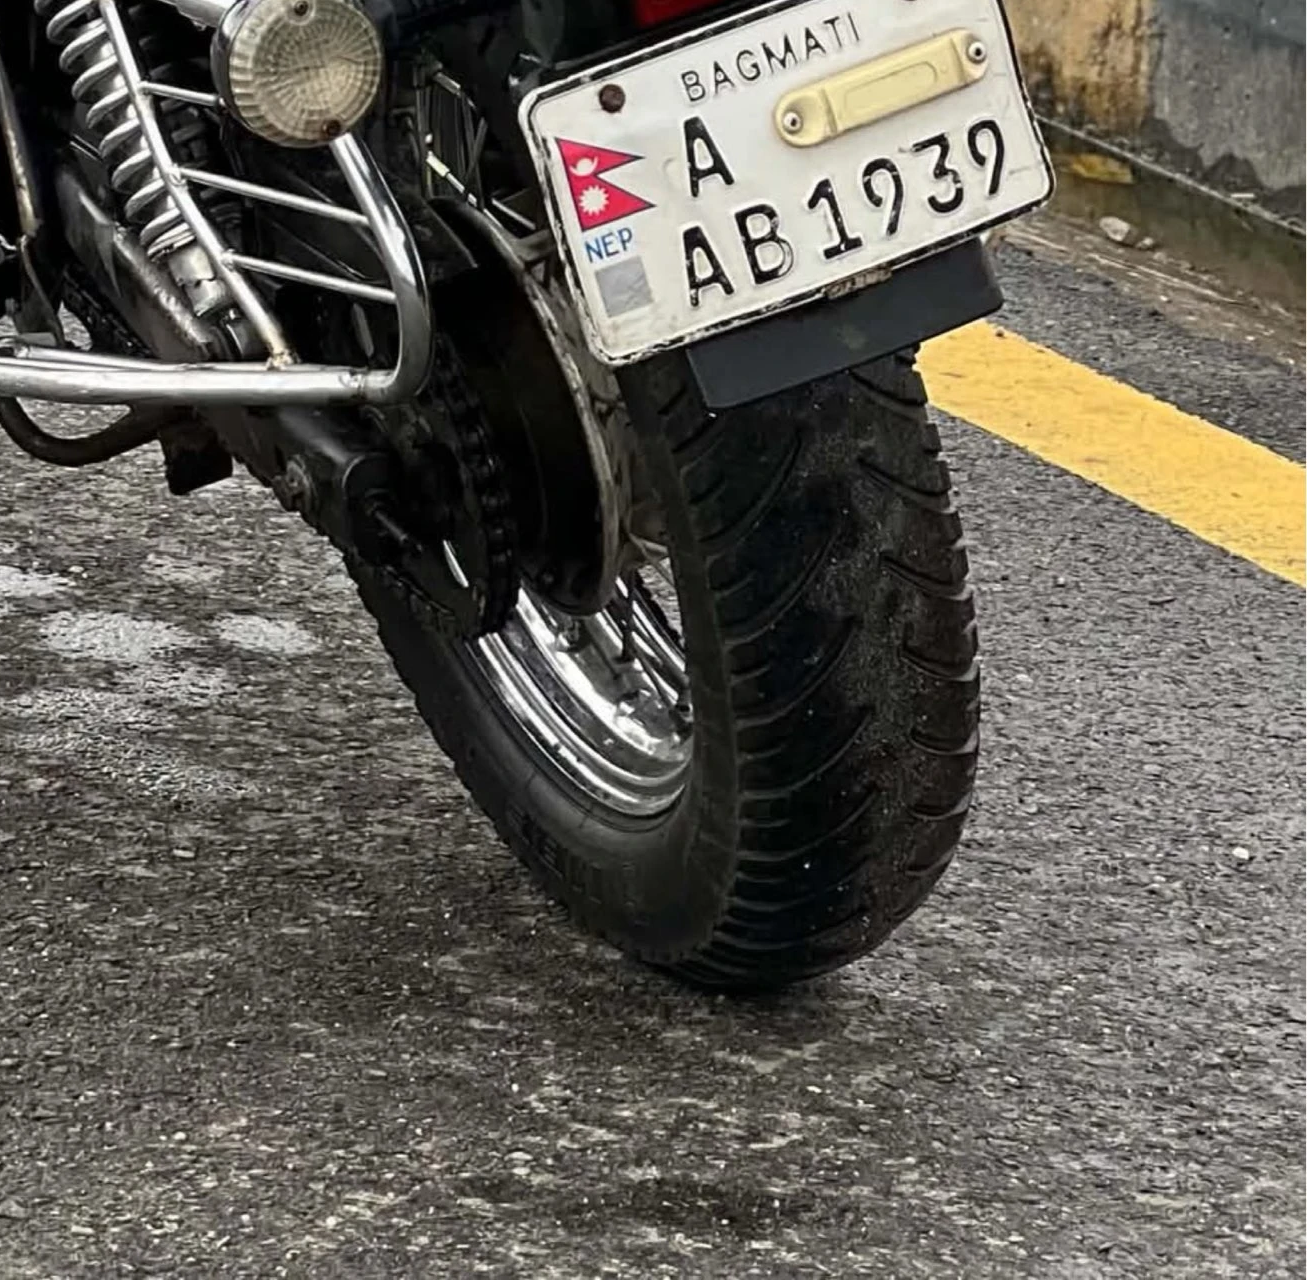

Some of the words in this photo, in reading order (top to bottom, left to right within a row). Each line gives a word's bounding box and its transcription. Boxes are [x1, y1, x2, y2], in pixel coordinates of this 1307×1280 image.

[681, 11, 860, 102] BAGMATI
[682, 116, 735, 198] A
[585, 227, 633, 263] NEP
